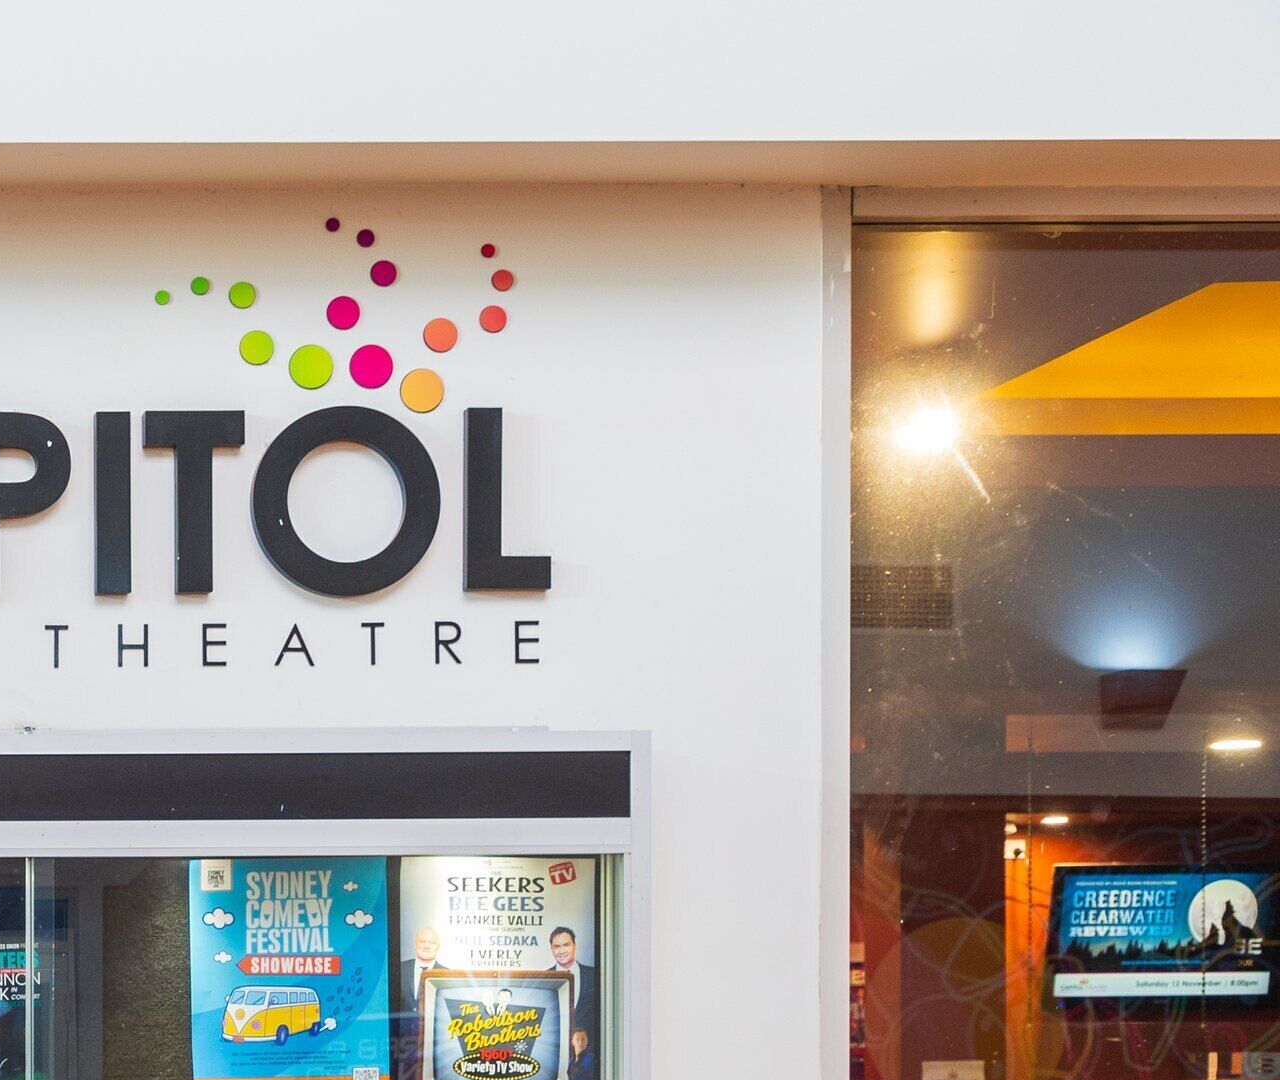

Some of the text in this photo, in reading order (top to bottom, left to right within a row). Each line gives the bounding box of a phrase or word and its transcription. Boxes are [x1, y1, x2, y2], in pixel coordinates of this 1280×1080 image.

[44, 620, 541, 667] THEATRE
[246, 870, 332, 900] SYDNEY
[447, 877, 545, 893] SEEKERS
[1073, 889, 1176, 909] CREEDENCE
[245, 898, 333, 929] COMEDY
[1071, 908, 1175, 925] CLEARWATER
[246, 927, 334, 954] FESTIVAL
[1068, 925, 1173, 938] REVIEWED
[250, 957, 332, 974] SHOWCASE
[460, 1003, 480, 1016] The
[448, 1008, 538, 1039] Robertson
[465, 1024, 542, 1051] Brothers
[461, 1060, 534, 1075] Variety TV Show
